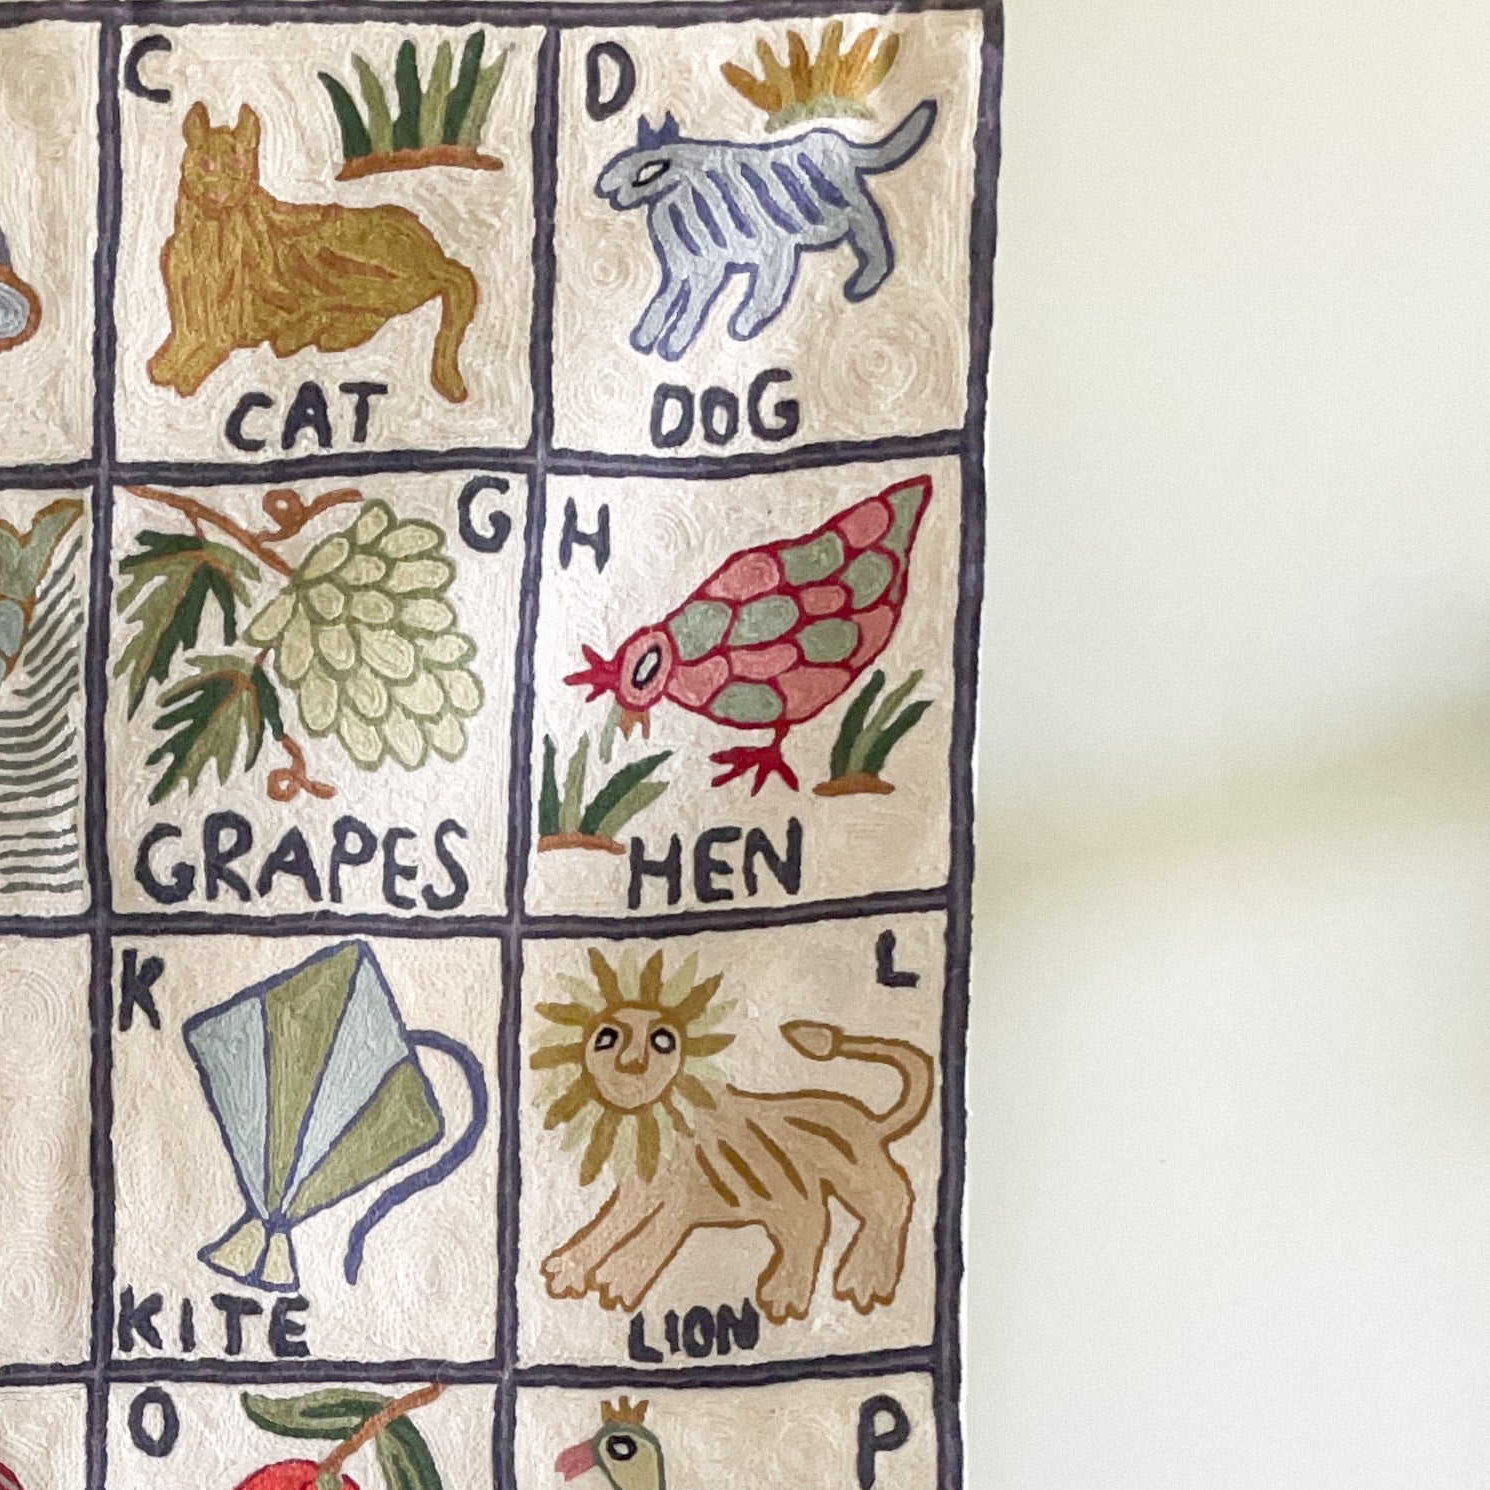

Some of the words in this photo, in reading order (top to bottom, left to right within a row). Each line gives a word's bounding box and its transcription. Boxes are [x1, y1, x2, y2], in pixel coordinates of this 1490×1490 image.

[125, 35, 171, 102] C
[587, 42, 635, 120] D
[226, 382, 387, 451] CAT
[652, 369, 799, 447] DOG
[459, 477, 510, 552] G
[561, 501, 609, 570] H
[135, 811, 468, 912] GRAPES
[628, 817, 804, 911] HEN
[119, 949, 164, 1031] K
[876, 930, 919, 988] L
[118, 1291, 309, 1357] KITE
[628, 1298, 759, 1363] LION
[129, 1387, 179, 1457] O
